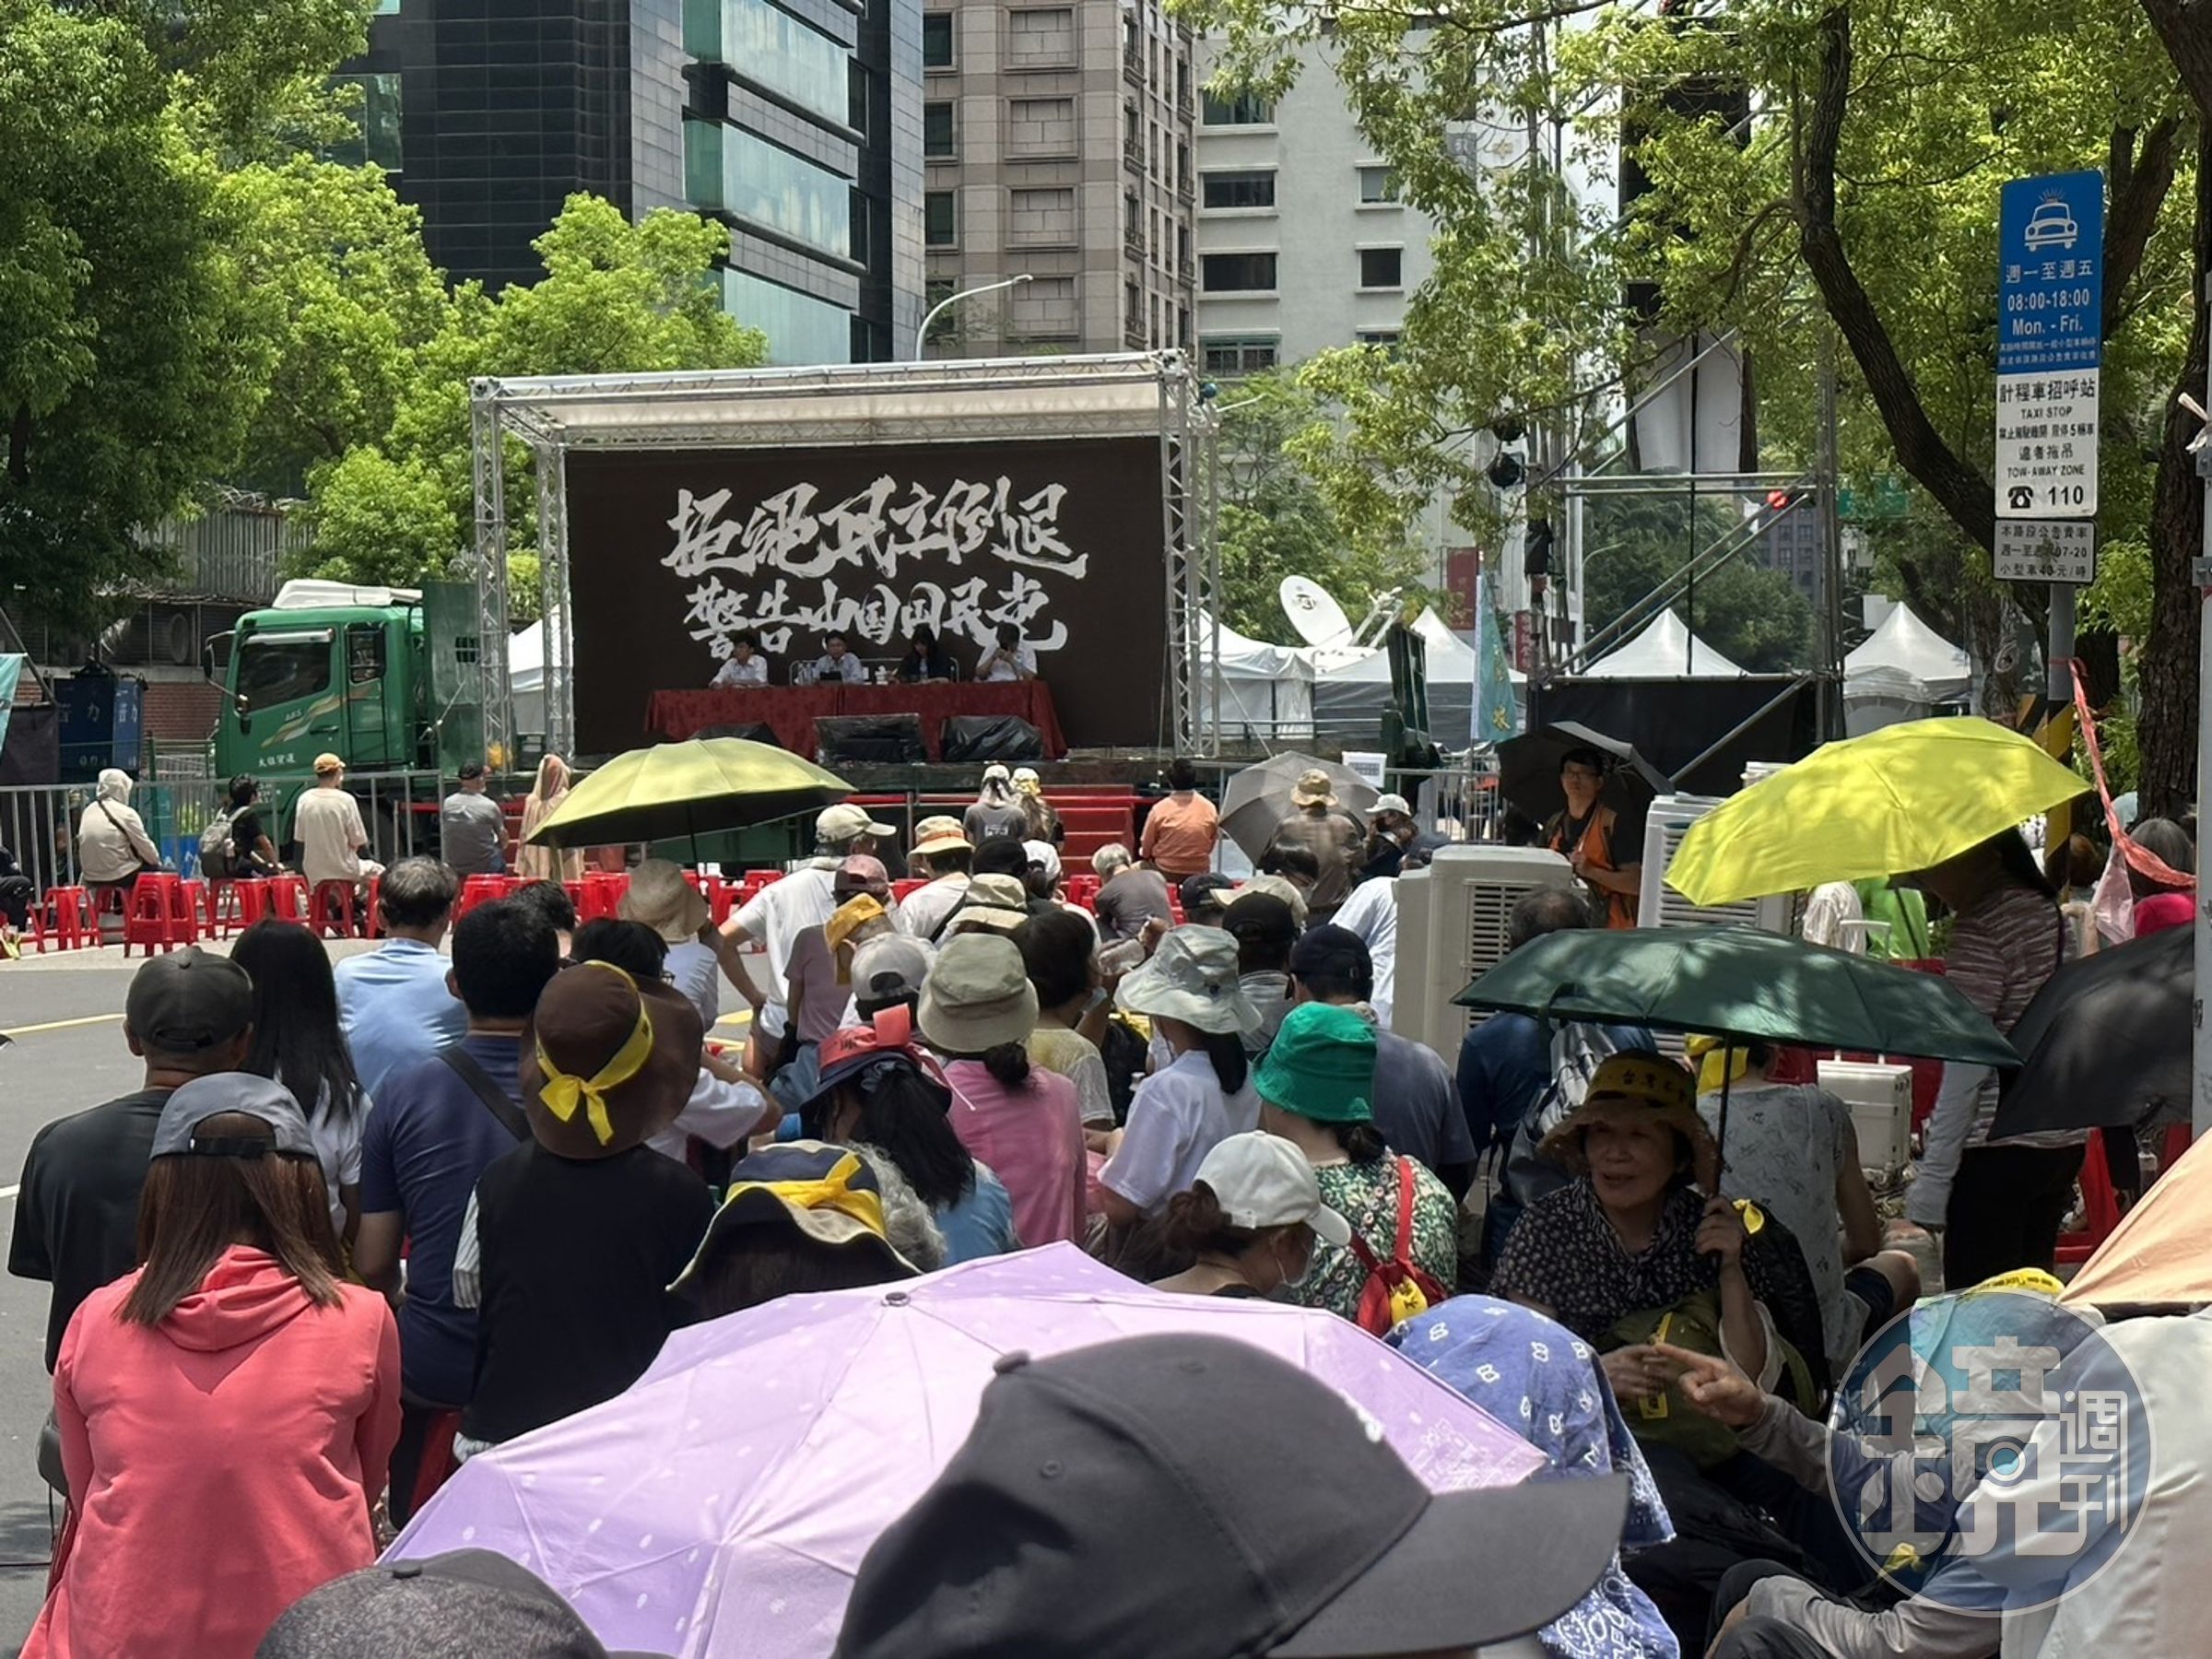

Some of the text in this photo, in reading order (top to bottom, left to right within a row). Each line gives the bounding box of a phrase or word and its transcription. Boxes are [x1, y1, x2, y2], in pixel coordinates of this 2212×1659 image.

[2006, 259, 2093, 284] 週一至週五
[2007, 288, 2089, 312] 08:00-18:00
[2012, 318, 2045, 335] Mon.
[2060, 314, 2083, 332] Fri.
[1999, 378, 2095, 403] 計程車招呼站
[2021, 406, 2073, 419] TAXI STOP
[2019, 443, 2073, 461] 違者拖吊
[2007, 464, 2085, 478] TOW-AWAY ZONE
[2048, 485, 2084, 506] 110
[660, 474, 1088, 579] 拒絕民主倒退
